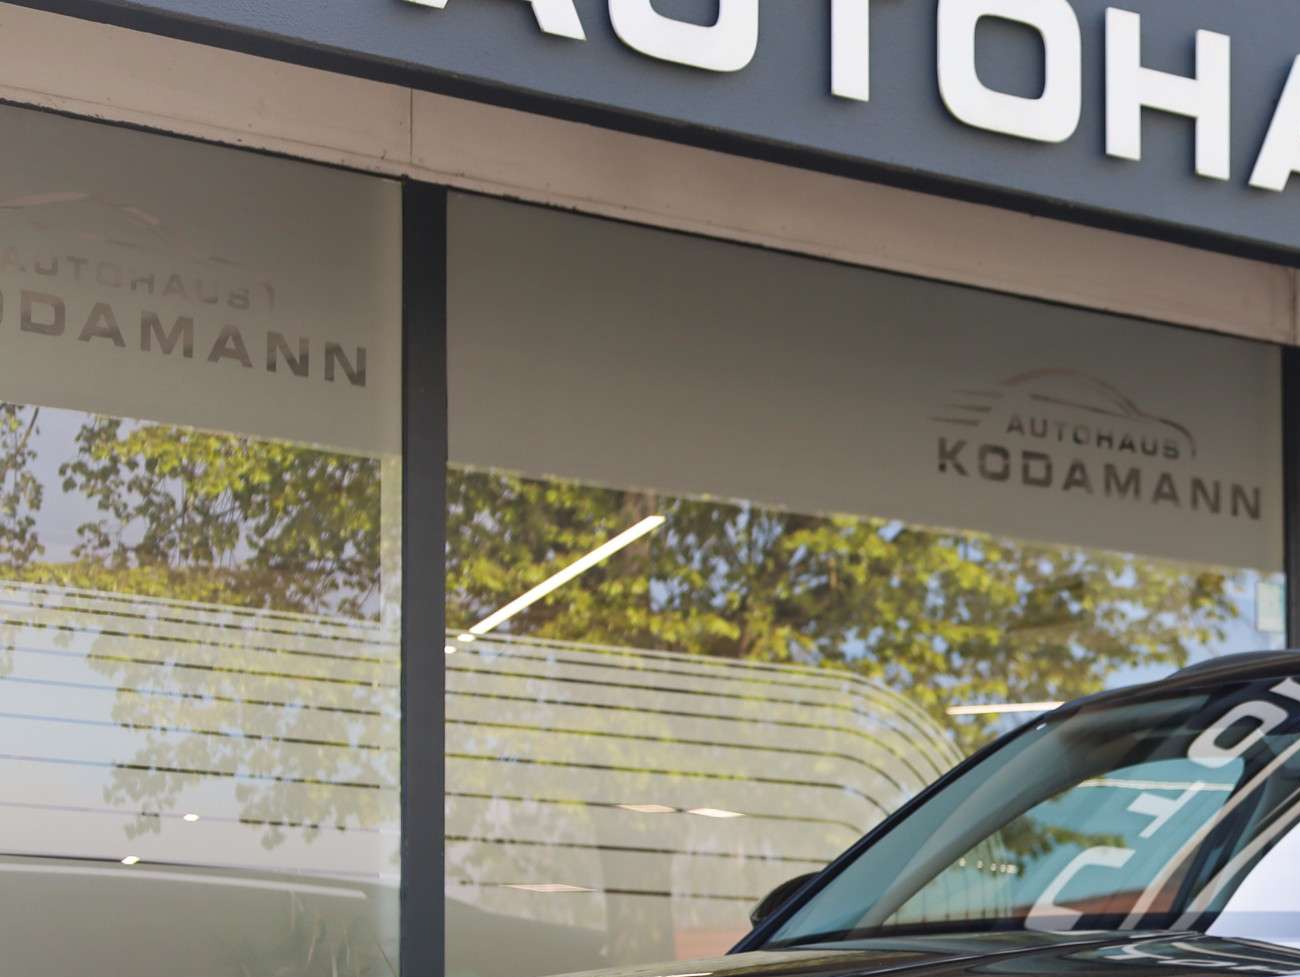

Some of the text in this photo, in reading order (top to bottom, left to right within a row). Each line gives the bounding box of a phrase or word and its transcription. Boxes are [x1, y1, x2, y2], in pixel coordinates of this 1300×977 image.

[0, 288, 367, 388] DAMANN
[937, 436, 1262, 521] KODAMANN
[1006, 414, 1180, 460] AUTOHAUS
